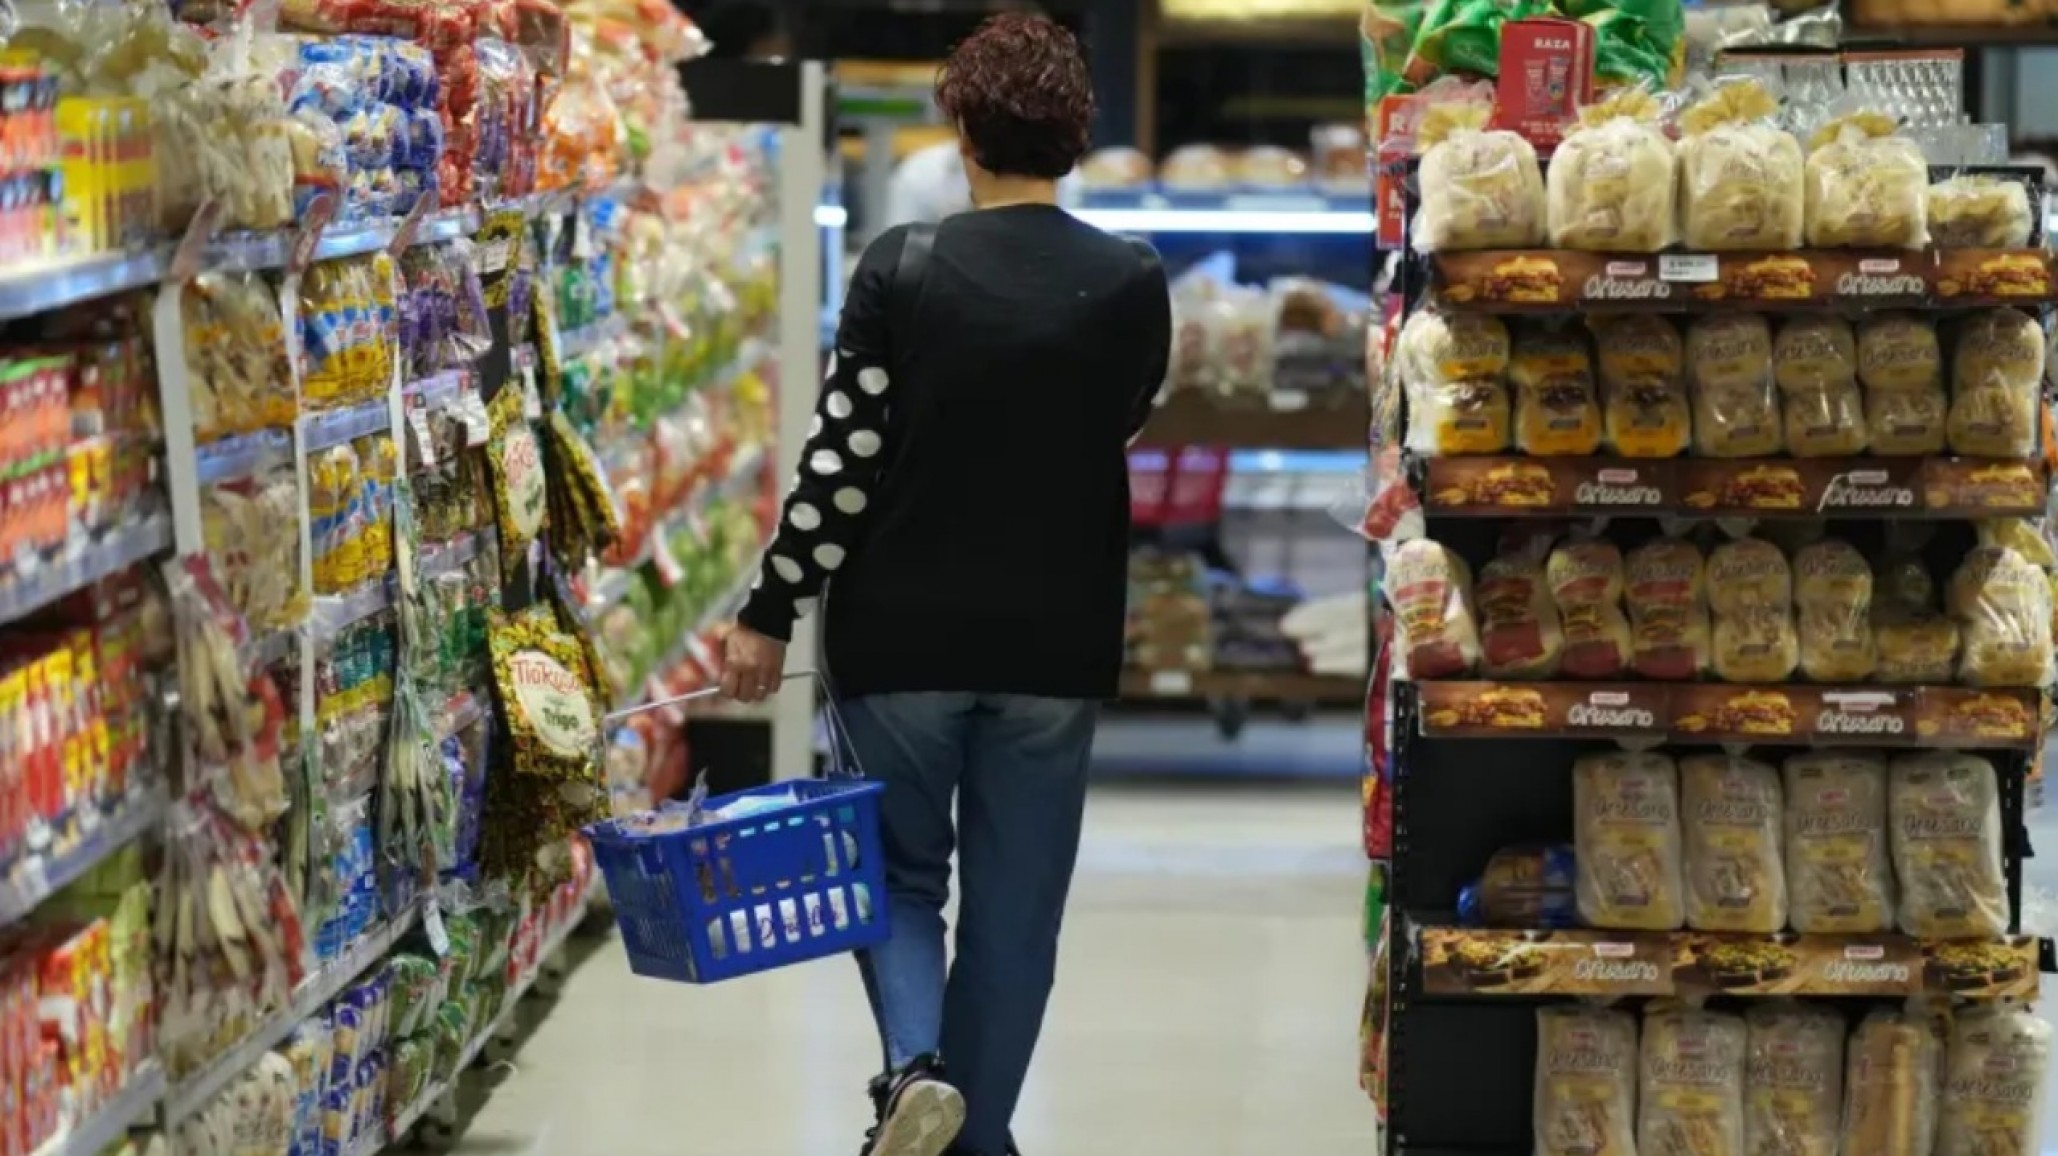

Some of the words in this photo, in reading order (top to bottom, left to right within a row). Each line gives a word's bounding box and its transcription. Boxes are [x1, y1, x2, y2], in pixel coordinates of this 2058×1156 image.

[1584, 274, 1671, 299] Artesano
[1837, 272, 1925, 295] Artesano
[1568, 703, 1654, 727] Artesano
[1817, 711, 1904, 734] Artesano
